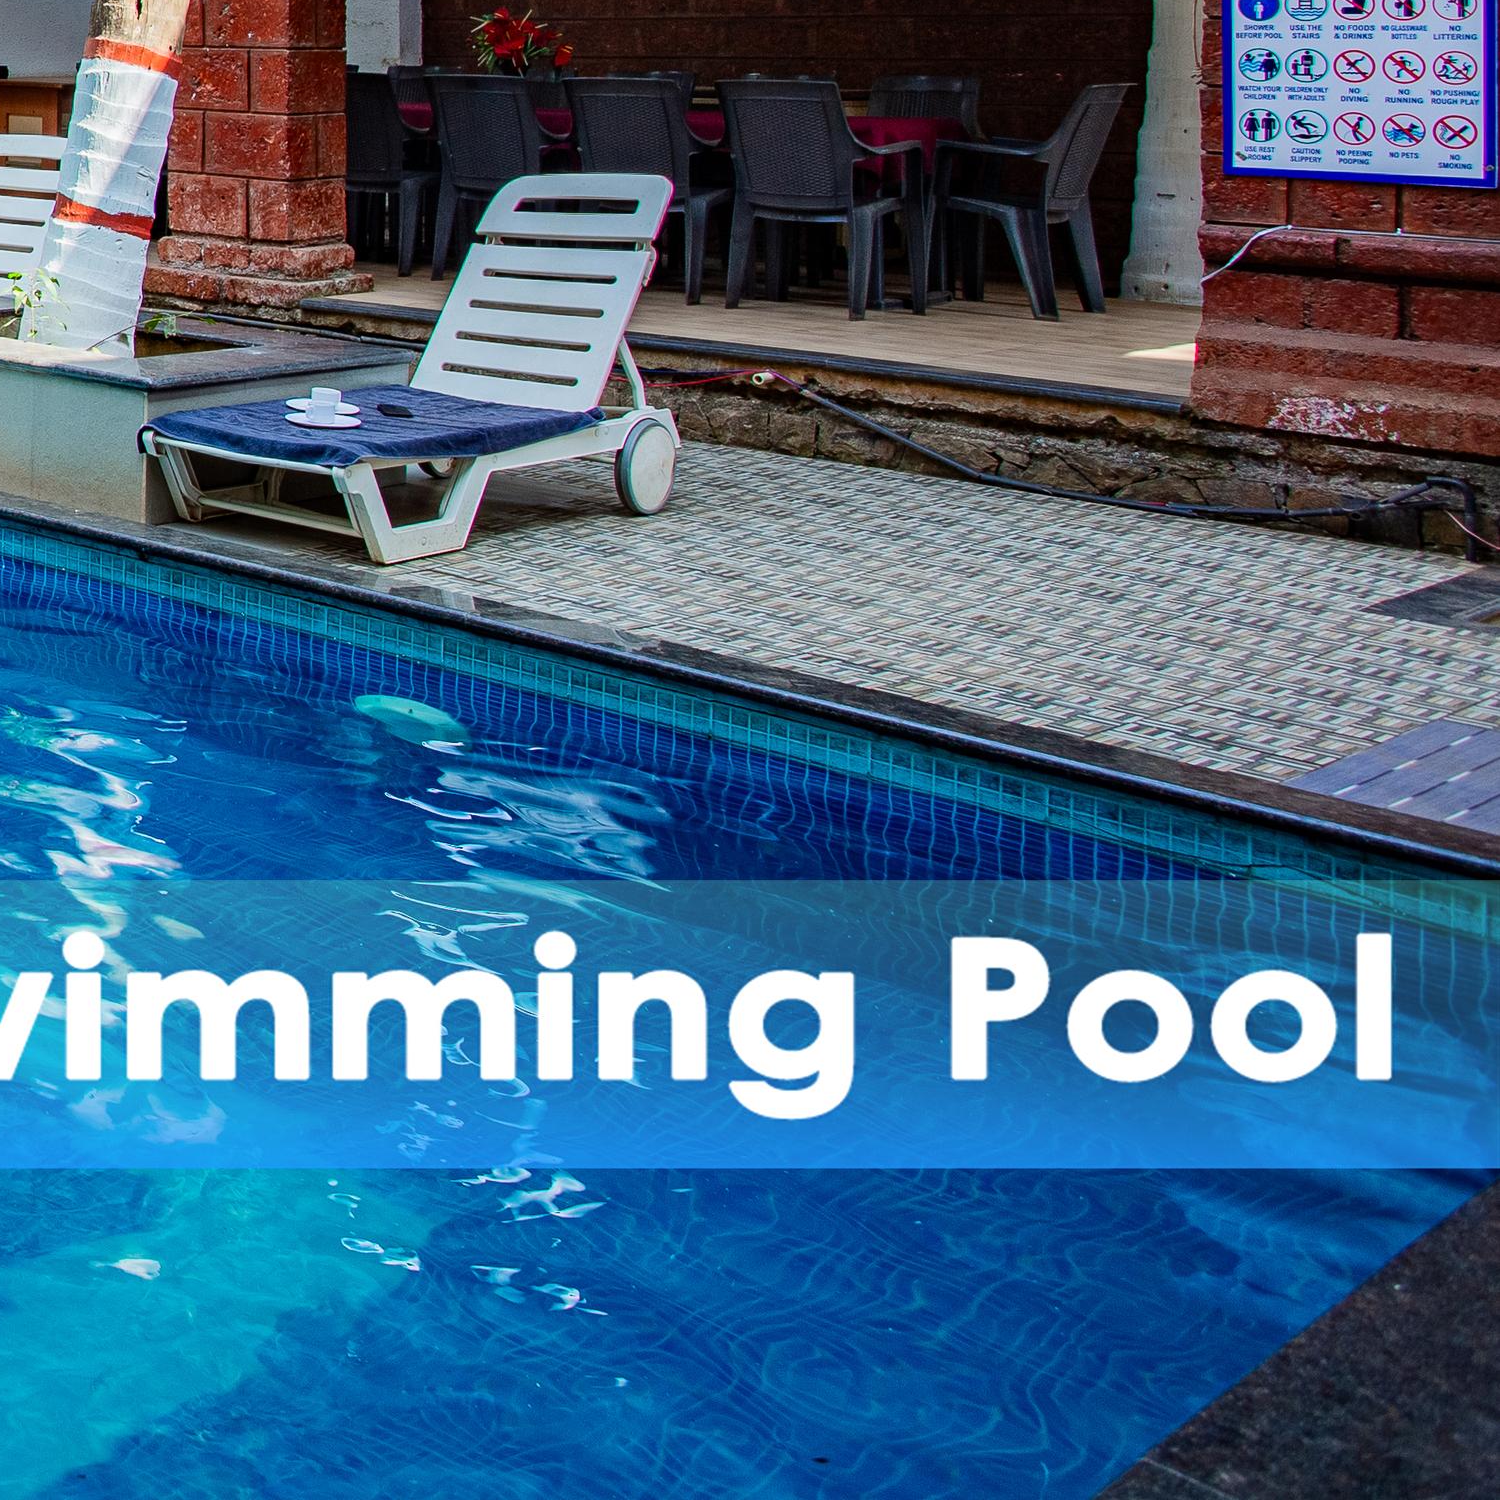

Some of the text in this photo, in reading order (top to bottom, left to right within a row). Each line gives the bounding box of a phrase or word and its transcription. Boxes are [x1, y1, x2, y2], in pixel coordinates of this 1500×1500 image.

[1459, 98, 1480, 106] PLAY
[1291, 147, 1320, 155] CAUTION
[1289, 155, 1322, 163] SLIPPERY
[1438, 162, 1473, 170] SMOKING
